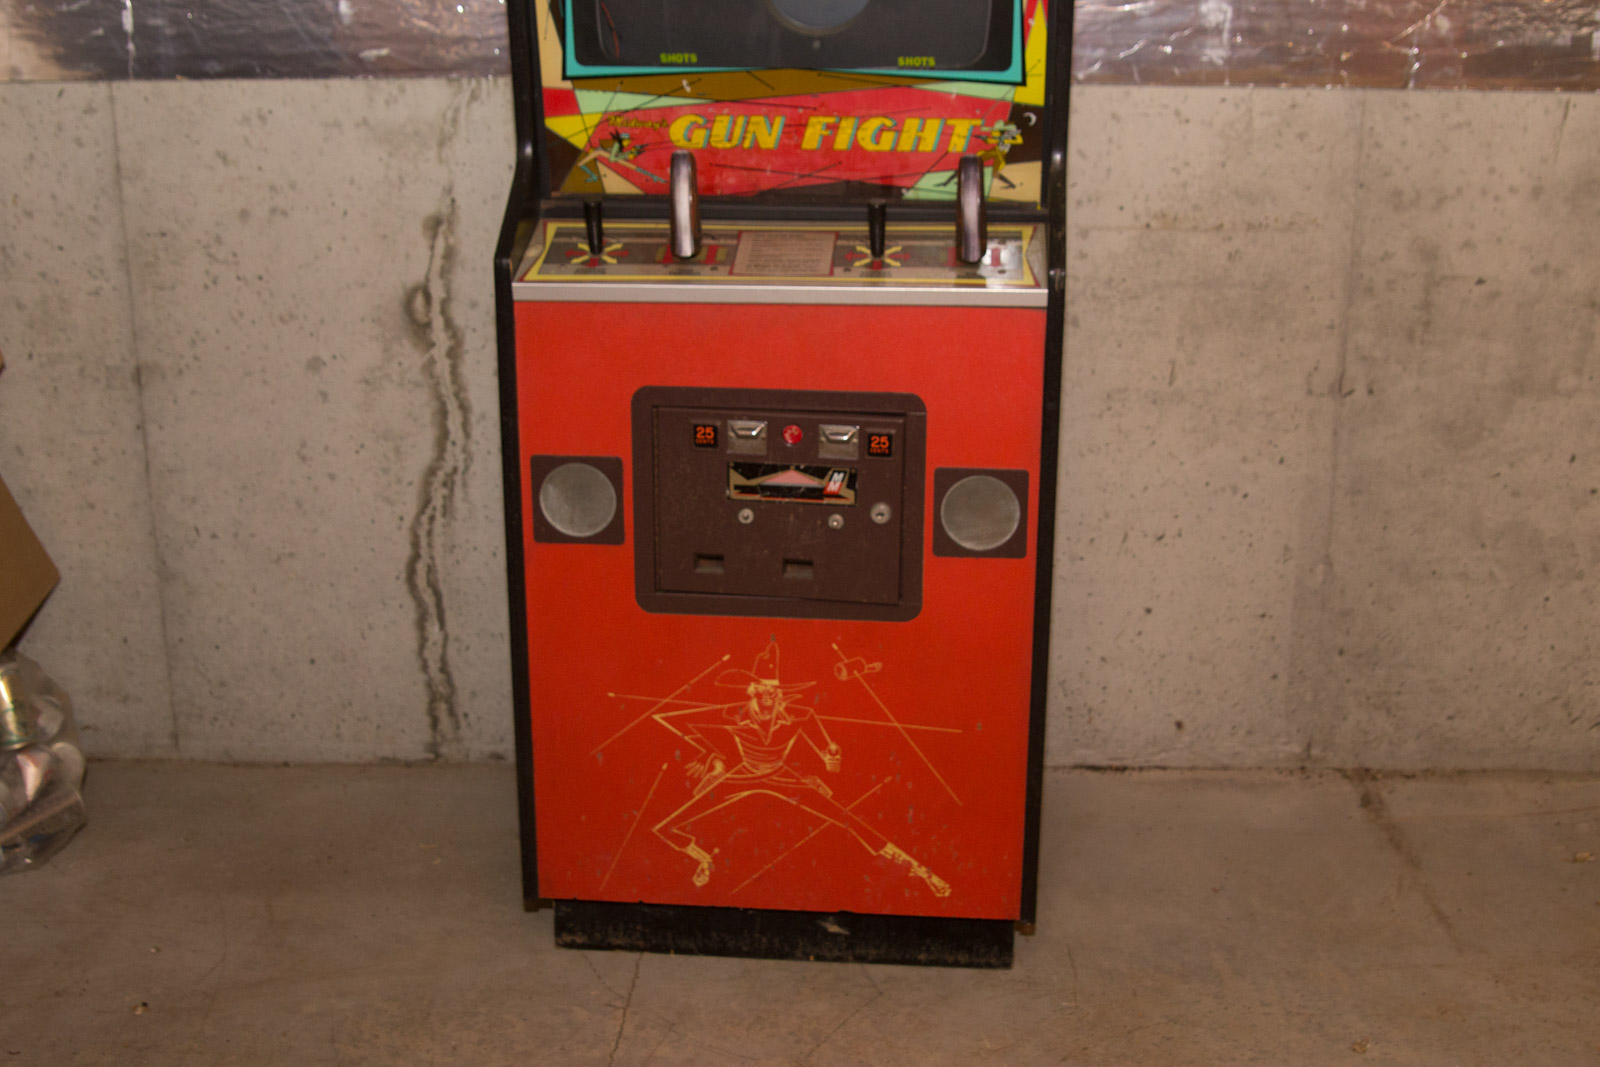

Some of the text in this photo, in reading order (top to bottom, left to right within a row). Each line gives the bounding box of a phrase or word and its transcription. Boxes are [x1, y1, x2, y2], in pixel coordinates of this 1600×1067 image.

[660, 52, 697, 64] SHOTS
[897, 56, 936, 67] SHOTS
[668, 113, 786, 150] GUN
[801, 115, 985, 153] FIGHT
[696, 426, 714, 439] 25
[871, 436, 889, 448] 25
